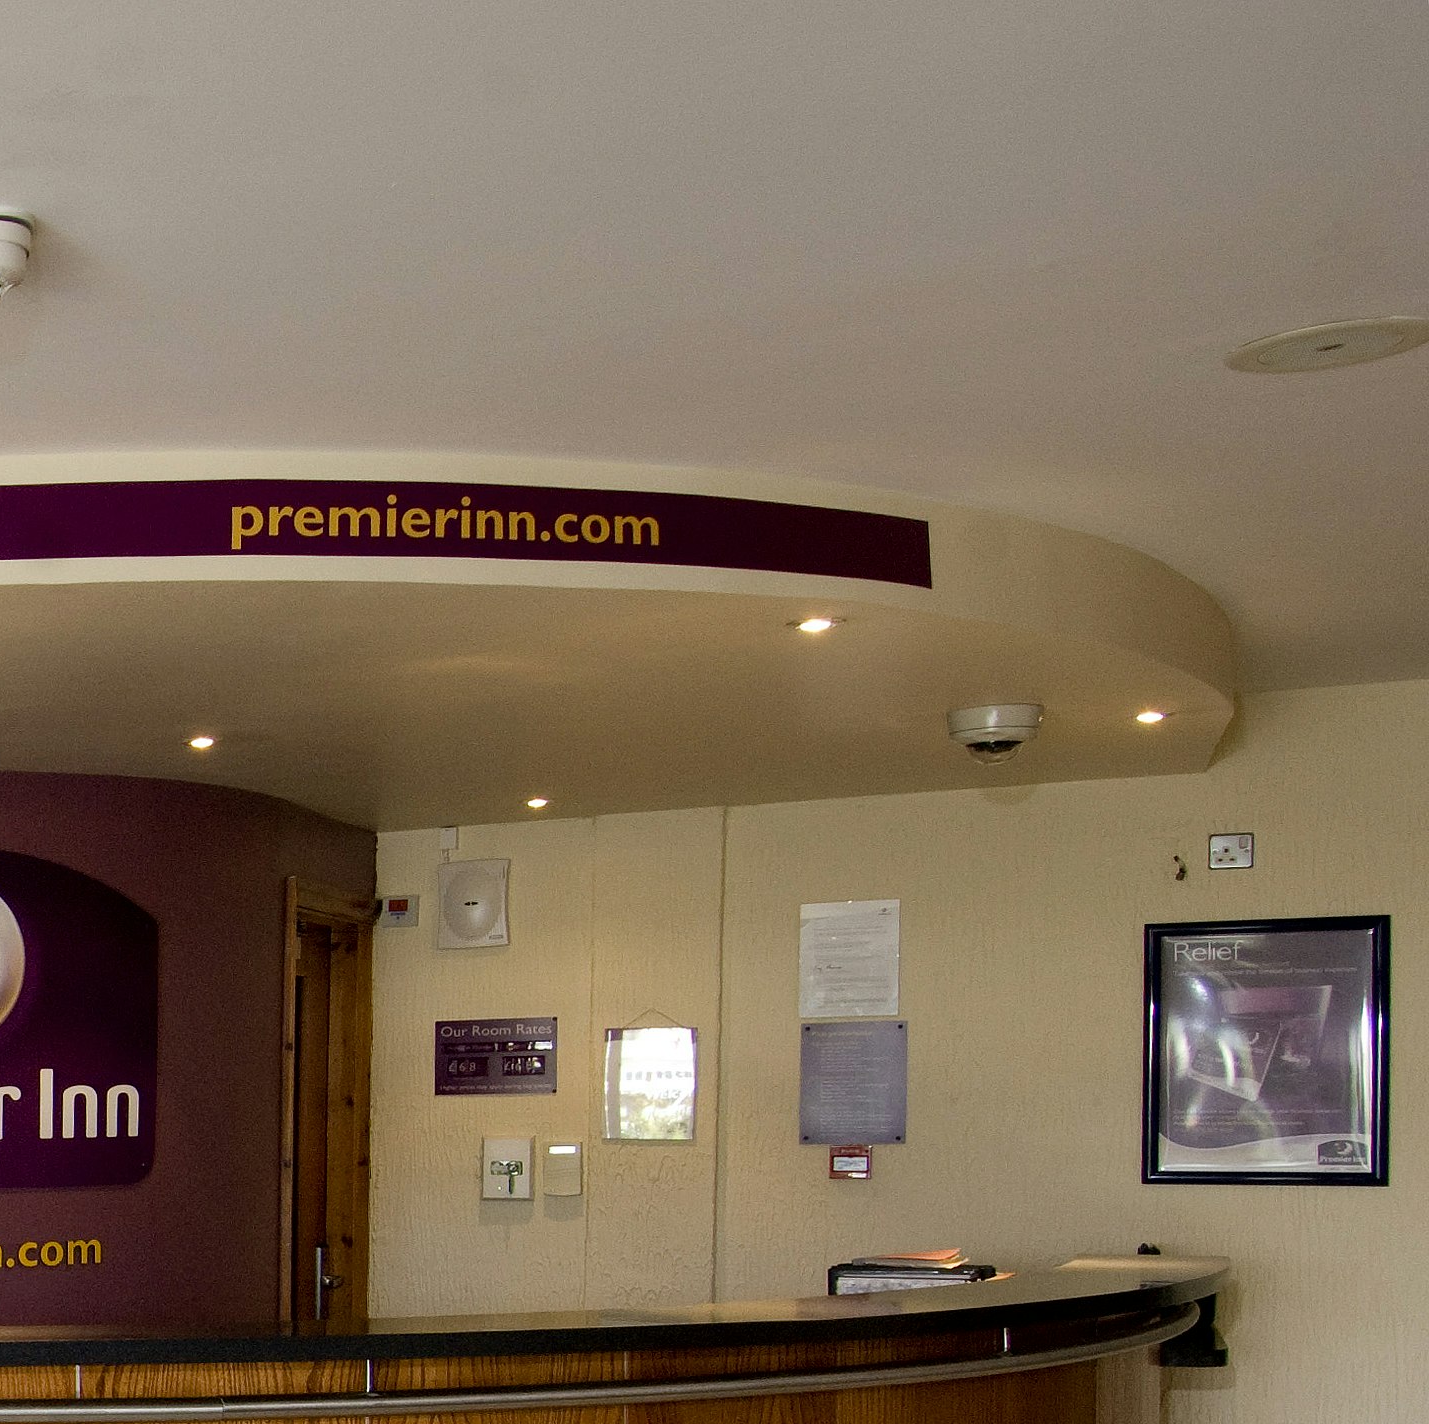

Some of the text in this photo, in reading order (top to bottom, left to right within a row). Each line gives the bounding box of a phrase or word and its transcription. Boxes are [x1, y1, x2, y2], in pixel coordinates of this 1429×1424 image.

[231, 494, 660, 550] premierinn.com
[1173, 940, 1241, 962] Relief
[441, 1024, 552, 1038] Our Room Rates
[39, 1068, 140, 1140] Inn
